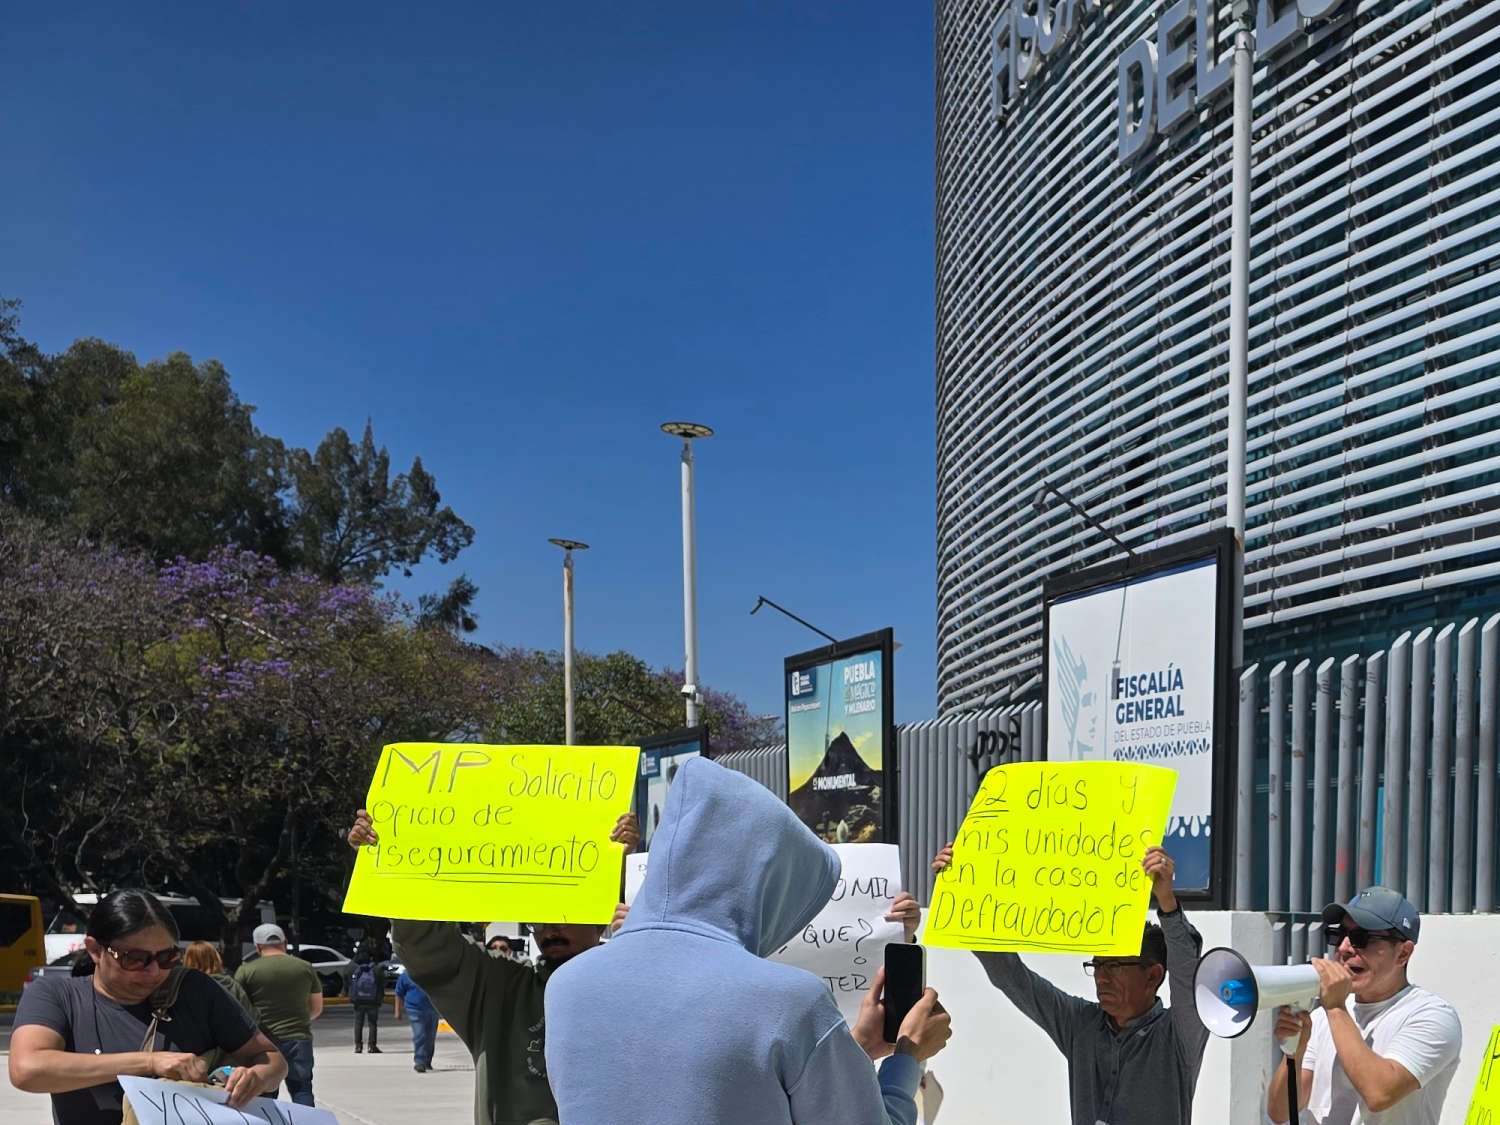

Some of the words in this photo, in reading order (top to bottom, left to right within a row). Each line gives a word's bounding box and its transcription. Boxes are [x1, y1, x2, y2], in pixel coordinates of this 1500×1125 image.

[844, 660, 876, 685] PUEBLA
[1116, 661, 1184, 700] FISCALÍA
[1115, 694, 1185, 725] GENERAL
[1114, 730, 1129, 743] DEL
[1130, 725, 1162, 741] ESTADO
[1164, 723, 1176, 737] DE
[1177, 719, 1211, 735] PUEBLA
[1026, 770, 1088, 811] días
[473, 803, 514, 827] de
[995, 858, 1018, 888] la
[1034, 864, 1098, 889] casa
[933, 890, 1134, 939] Defraudador
